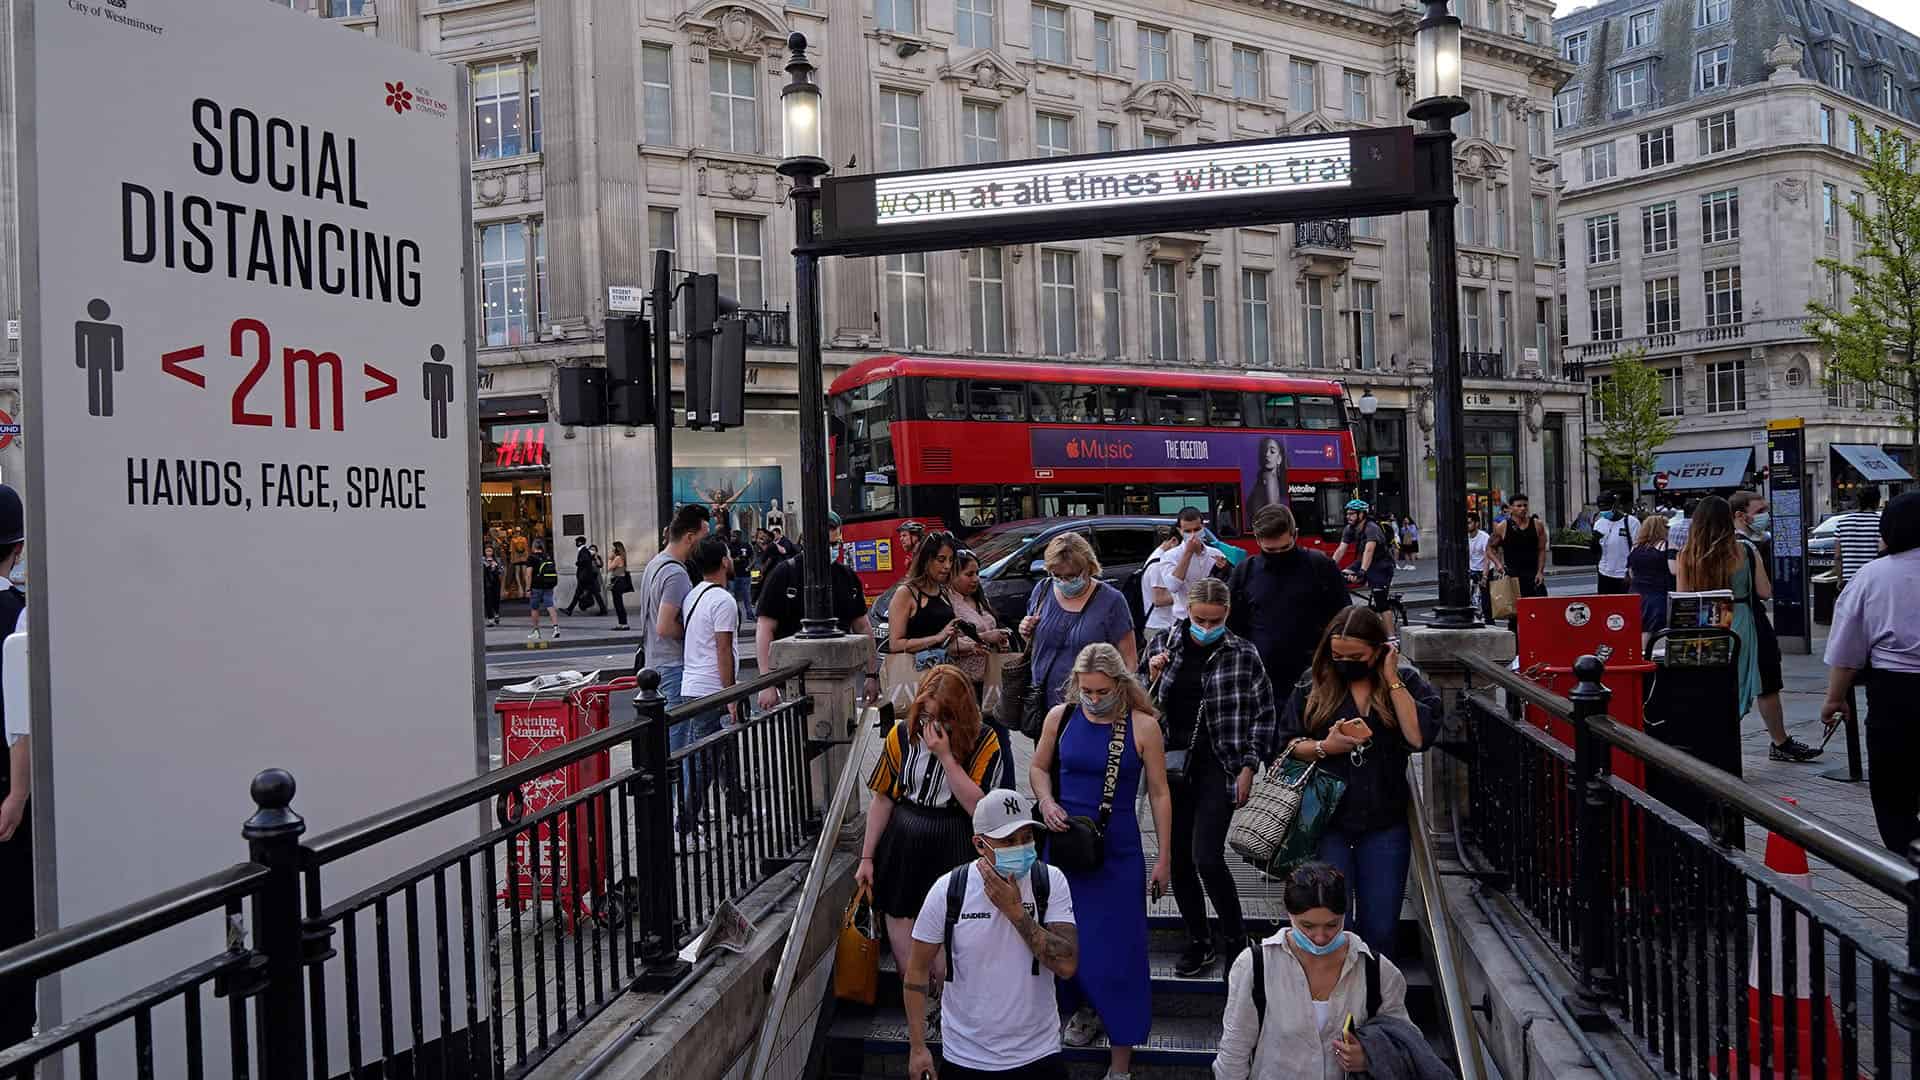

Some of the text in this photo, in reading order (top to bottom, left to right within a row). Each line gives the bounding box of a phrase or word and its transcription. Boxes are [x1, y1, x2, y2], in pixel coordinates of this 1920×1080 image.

[104, 8, 163, 34] Westminster
[192, 97, 369, 210] SOCIAL
[879, 189, 956, 216] worn
[970, 182, 1004, 208] at
[1014, 176, 1054, 204] all
[1062, 171, 1163, 200] times
[1173, 161, 1273, 193] when
[121, 182, 422, 308] DISTANCING
[229, 318, 345, 432] 2m
[495, 427, 545, 468] H&M
[1080, 439, 1134, 460] Music
[1164, 439, 1209, 460] THE AGENDA
[127, 456, 426, 513] HANDS, FACE, SPACE
[1662, 466, 1725, 478] NERO
[510, 726, 565, 738] Standard
[511, 714, 558, 729] Evening
[1003, 796, 1022, 816] NY
